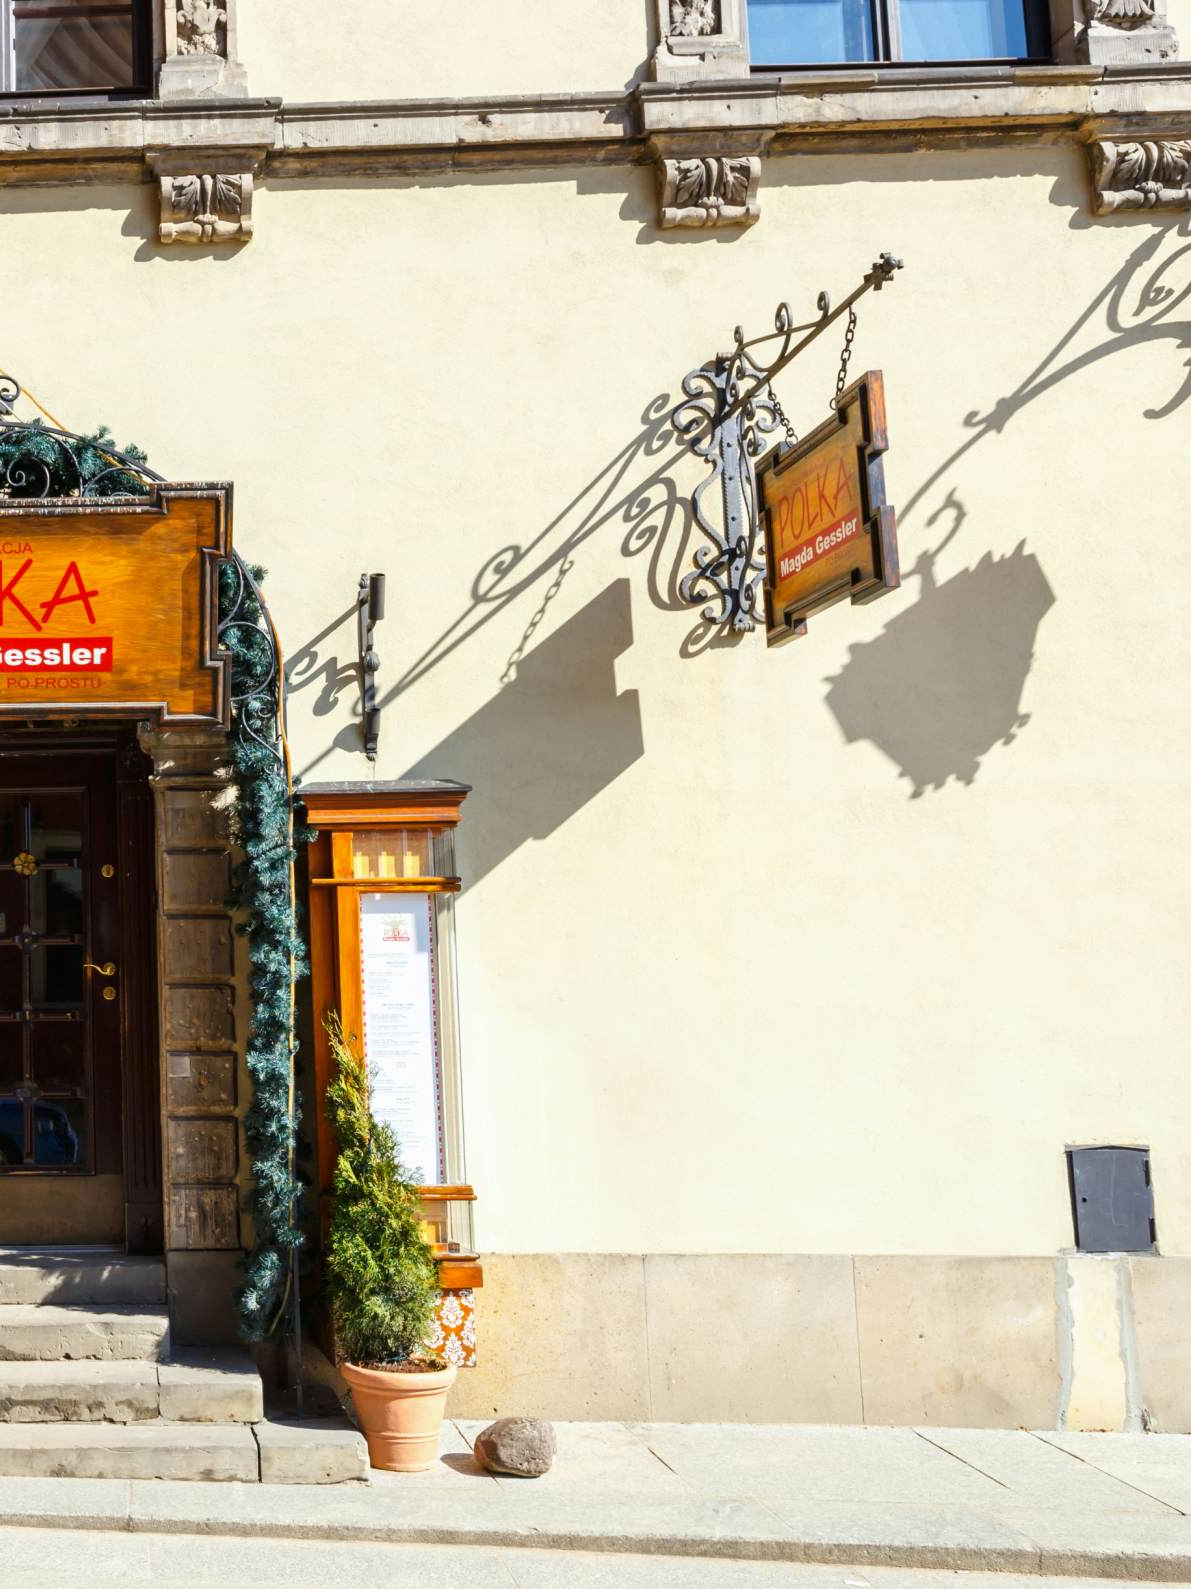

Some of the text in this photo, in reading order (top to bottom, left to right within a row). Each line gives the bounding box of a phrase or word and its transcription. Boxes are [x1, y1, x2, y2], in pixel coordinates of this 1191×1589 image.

[778, 457, 853, 548] POLKA
[780, 545, 814, 578] Magda
[815, 517, 858, 554] Gessler
[7, 676, 102, 690] PO PROSTU
